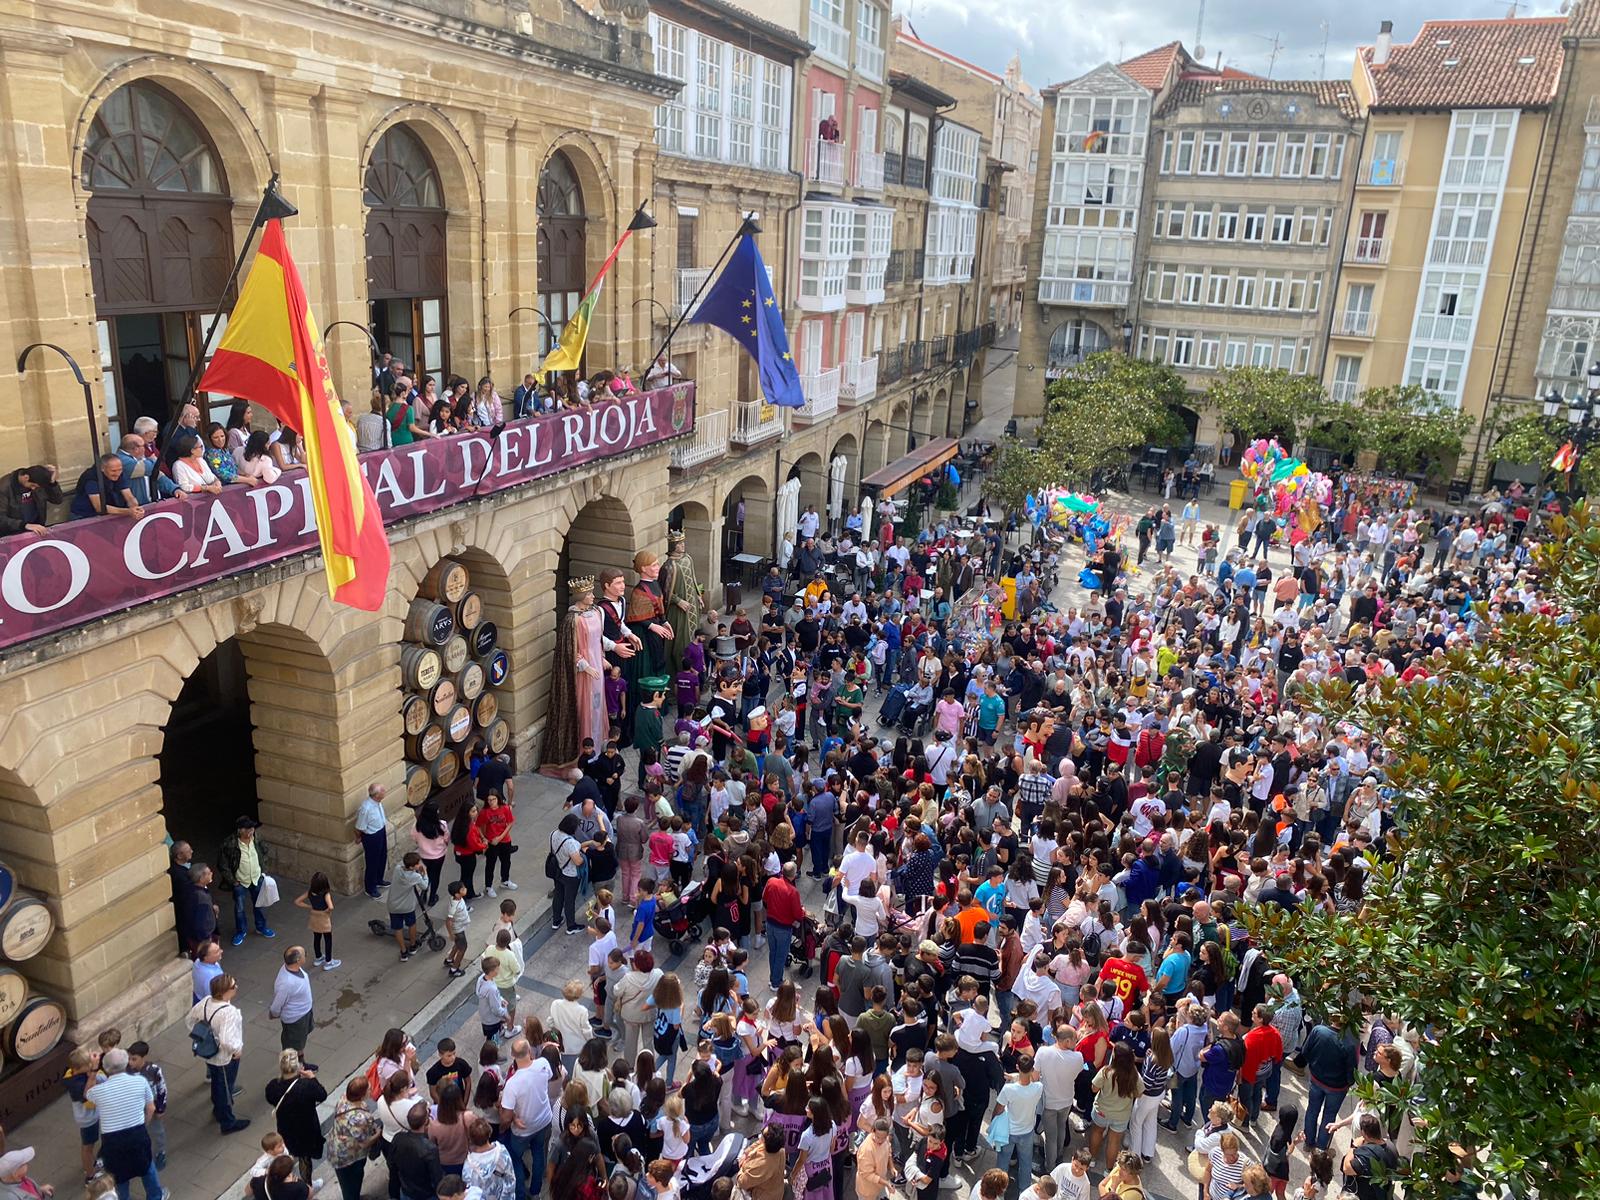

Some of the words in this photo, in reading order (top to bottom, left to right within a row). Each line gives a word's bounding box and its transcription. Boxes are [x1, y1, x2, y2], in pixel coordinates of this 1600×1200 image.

[124, 449, 446, 580] CAPIAL
[457, 423, 552, 488] DEL
[561, 397, 656, 458] RIOJA
[1113, 976, 1132, 1000] 19
